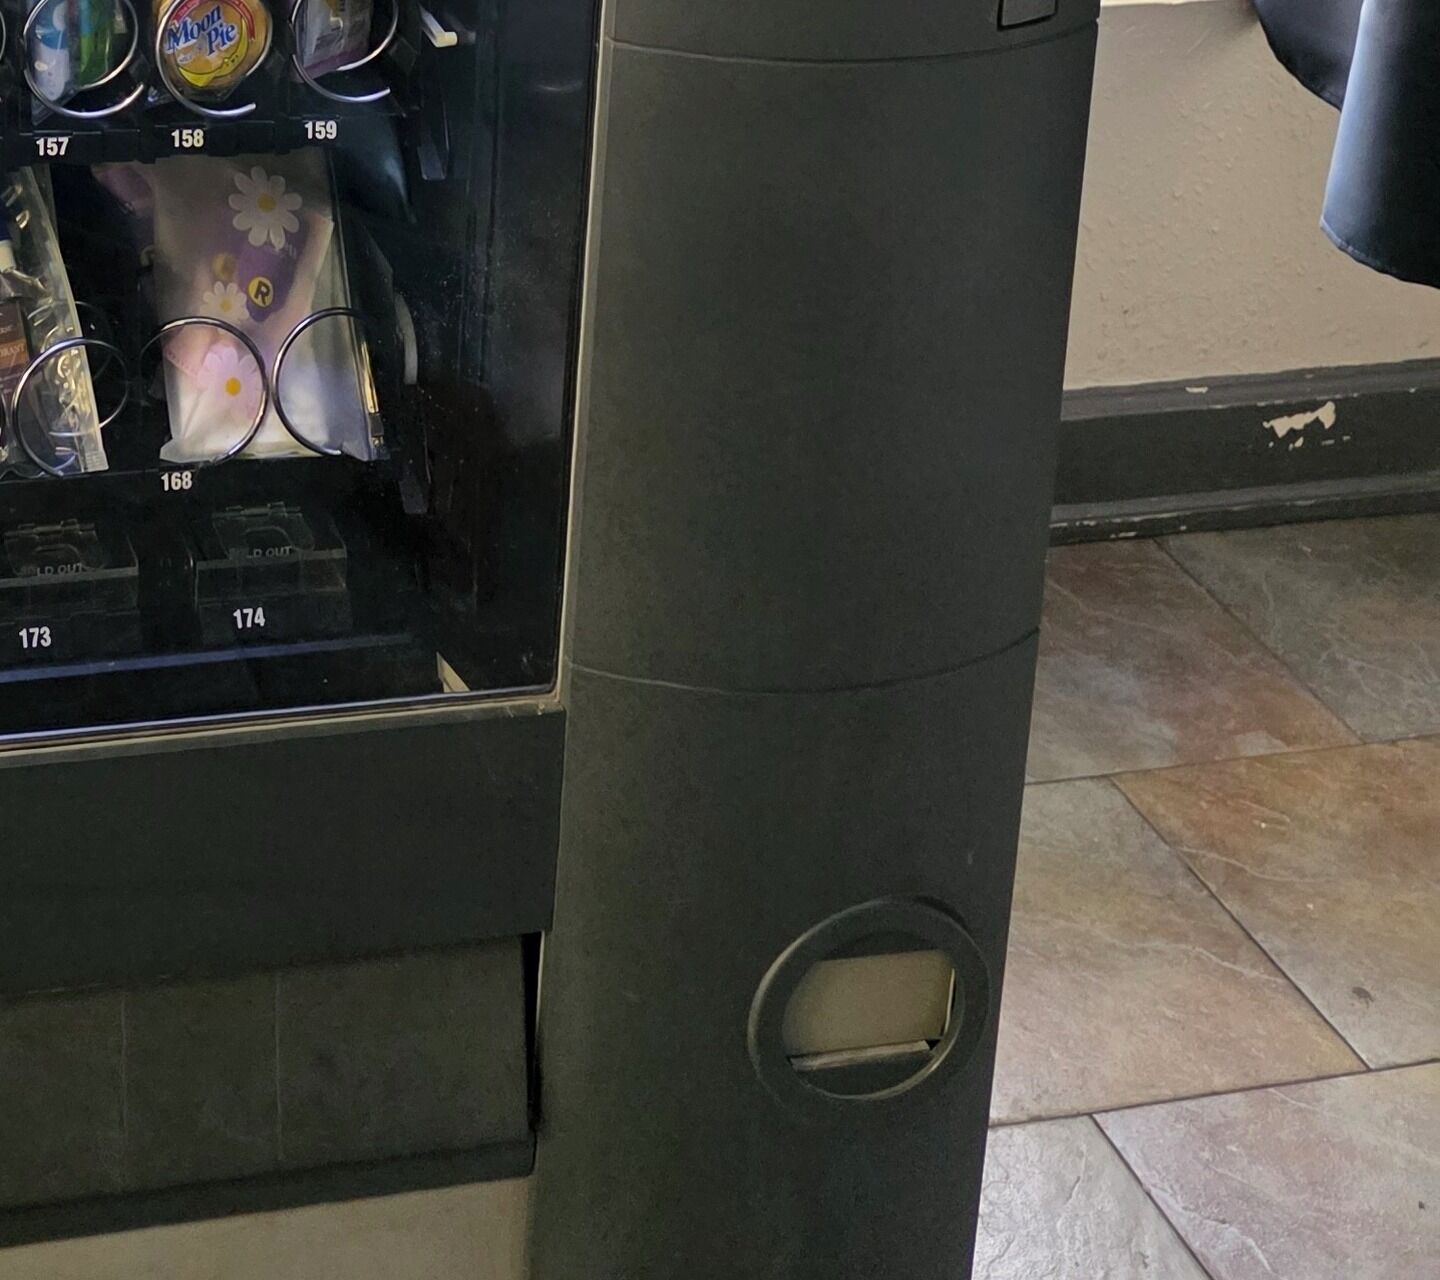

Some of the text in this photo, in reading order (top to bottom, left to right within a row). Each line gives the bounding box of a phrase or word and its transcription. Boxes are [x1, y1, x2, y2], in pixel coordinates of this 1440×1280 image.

[166, 4, 222, 52] Moon
[206, 23, 236, 57] Pie
[171, 128, 205, 148] 158
[304, 120, 338, 140] 159
[36, 137, 69, 157] 157
[161, 470, 193, 491] 168
[233, 606, 266, 629] 174
[19, 625, 52, 649] 173
